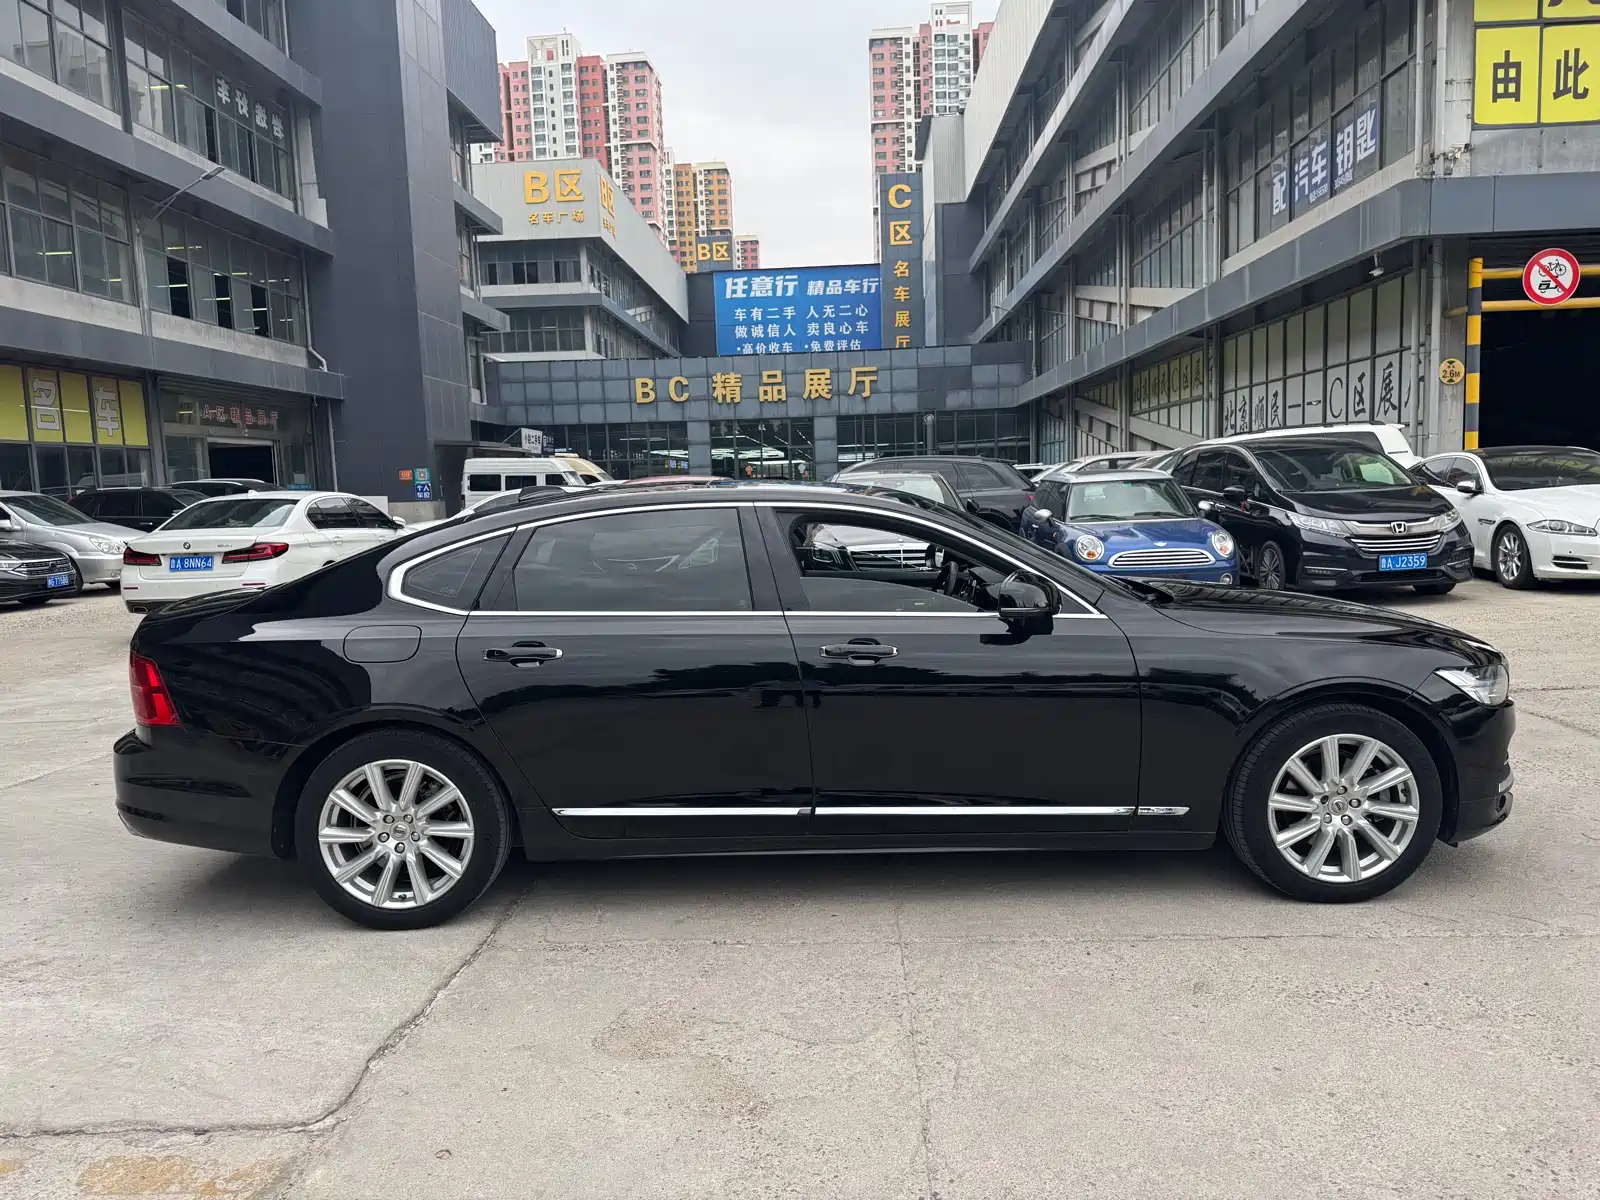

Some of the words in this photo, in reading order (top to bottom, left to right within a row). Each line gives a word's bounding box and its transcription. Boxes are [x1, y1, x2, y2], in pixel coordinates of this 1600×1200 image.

[1491, 48, 1590, 104] 由此
[1272, 109, 1377, 216] 配汽车钥匙
[523, 169, 585, 204] B区
[528, 208, 585, 225] 名车广场
[697, 241, 731, 262] B区
[724, 274, 799, 299] 任意行
[806, 277, 880, 297] 精品车行
[733, 306, 797, 322] 车有二手
[805, 303, 869, 320] 人无二心
[734, 323, 797, 340] 做诚信人
[806, 320, 869, 337] 卖良心车
[810, 338, 862, 353] 免费评估
[32, 377, 120, 437] 名车
